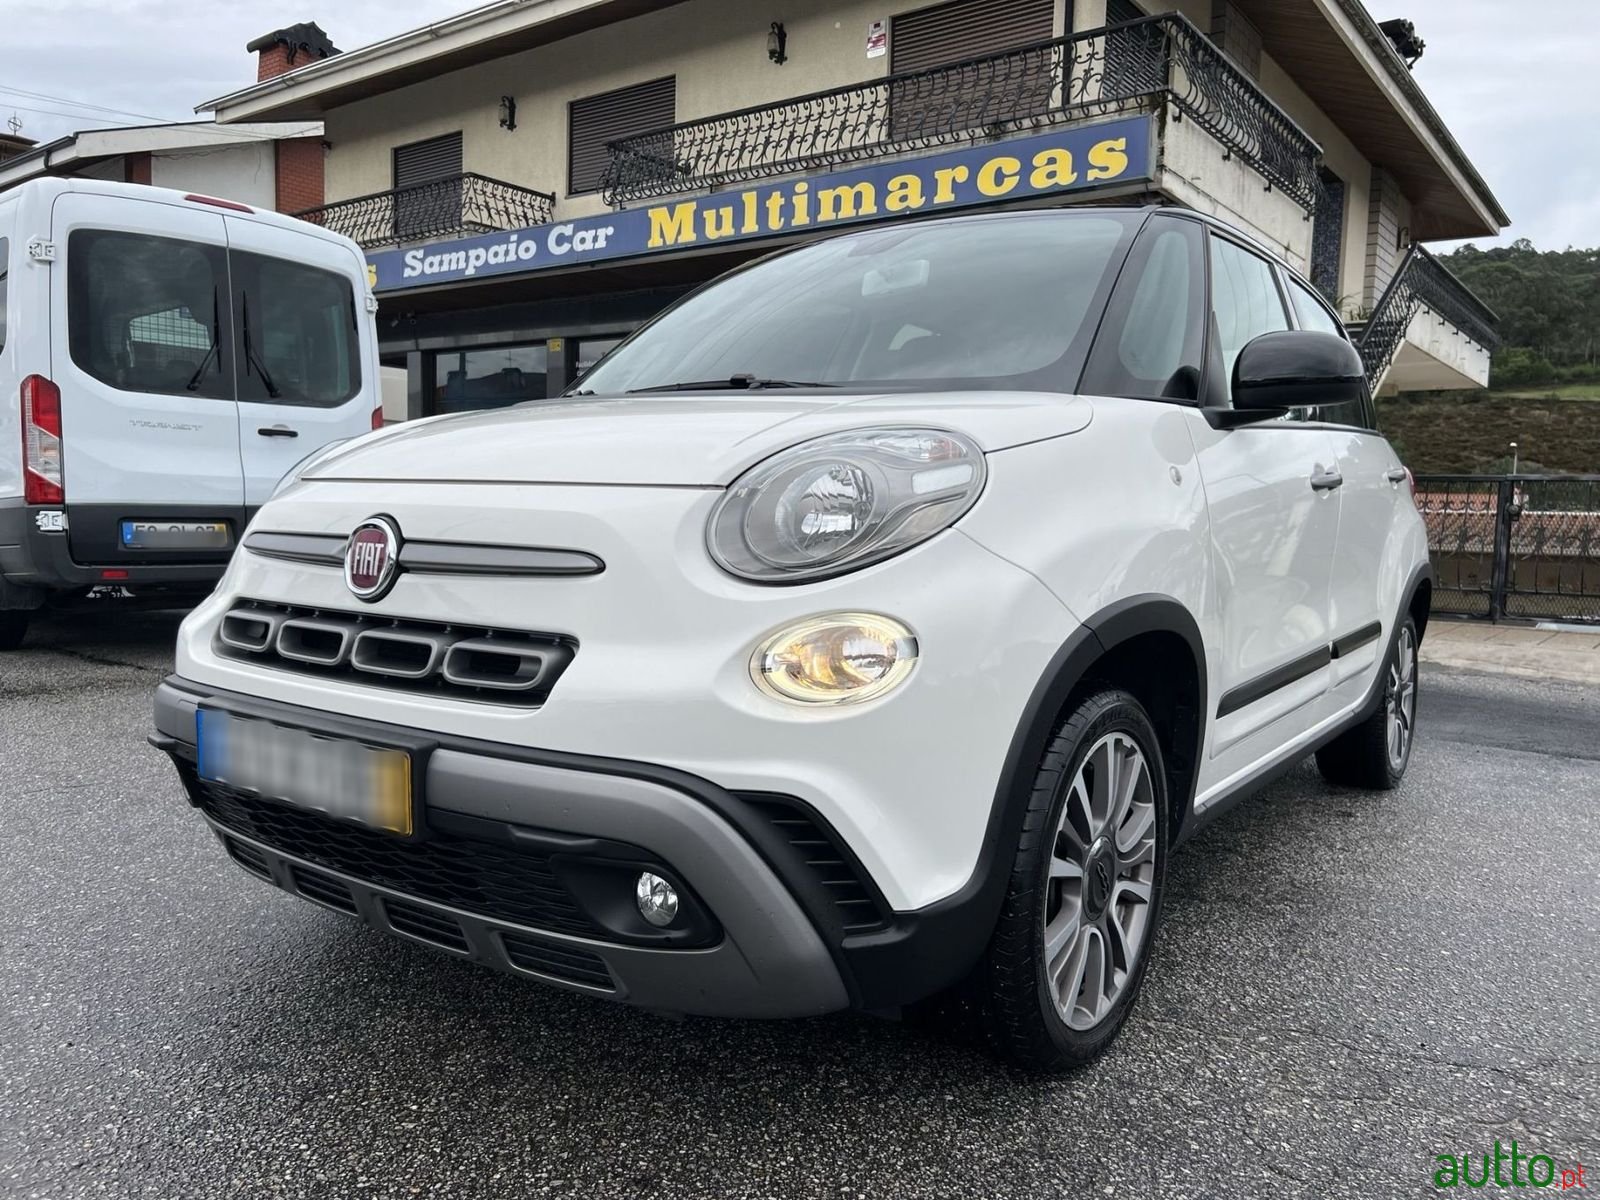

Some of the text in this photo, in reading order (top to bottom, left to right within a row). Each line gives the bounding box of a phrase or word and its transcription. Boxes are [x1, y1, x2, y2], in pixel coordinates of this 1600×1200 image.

[647, 137, 1129, 248] Multimarcas
[403, 223, 614, 278] Sampaio Car
[352, 542, 385, 577] FIAT
